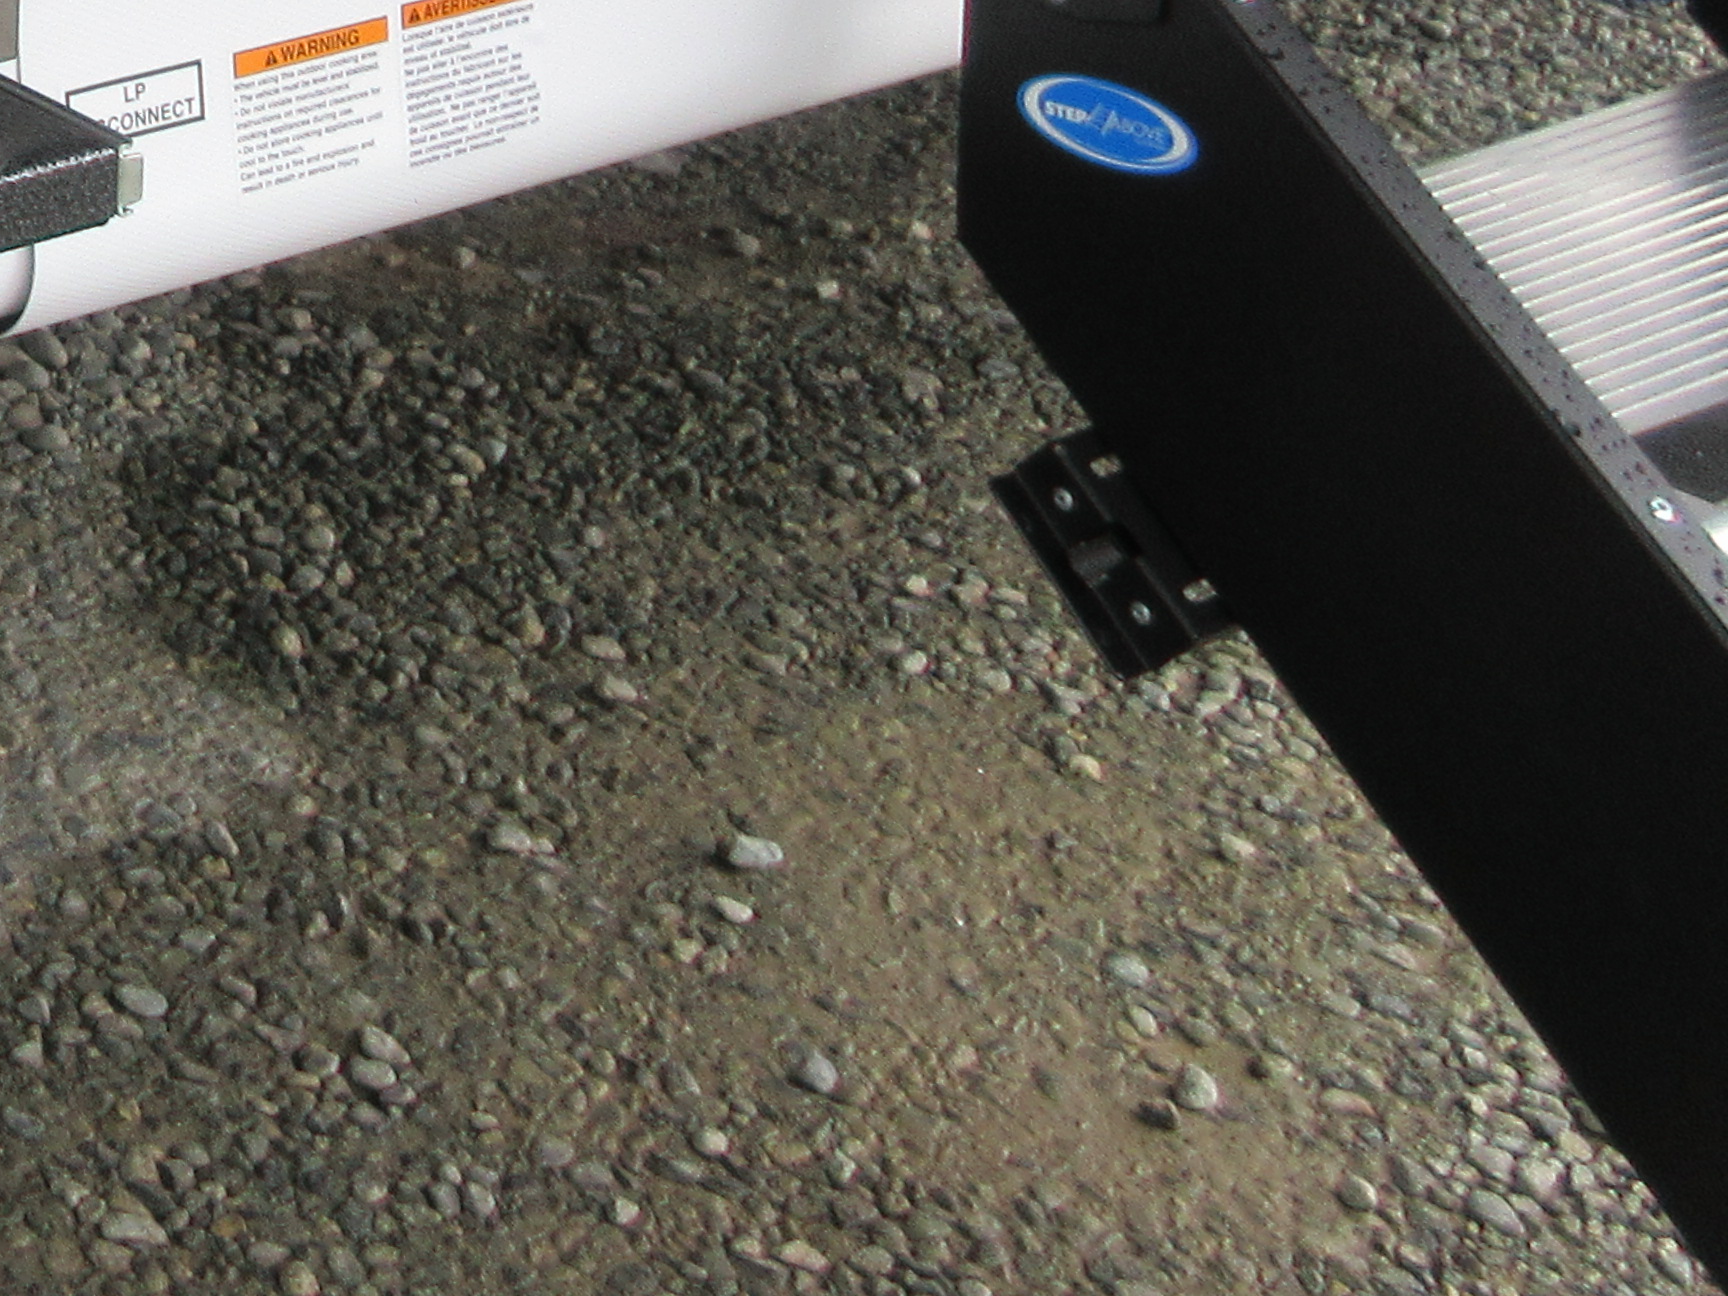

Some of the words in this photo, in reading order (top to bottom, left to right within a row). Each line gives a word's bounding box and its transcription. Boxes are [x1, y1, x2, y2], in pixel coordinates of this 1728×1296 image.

[281, 29, 359, 62] WARNING
[122, 82, 147, 104] LP
[97, 96, 195, 133] CONNECT
[1045, 99, 1089, 126] STEP
